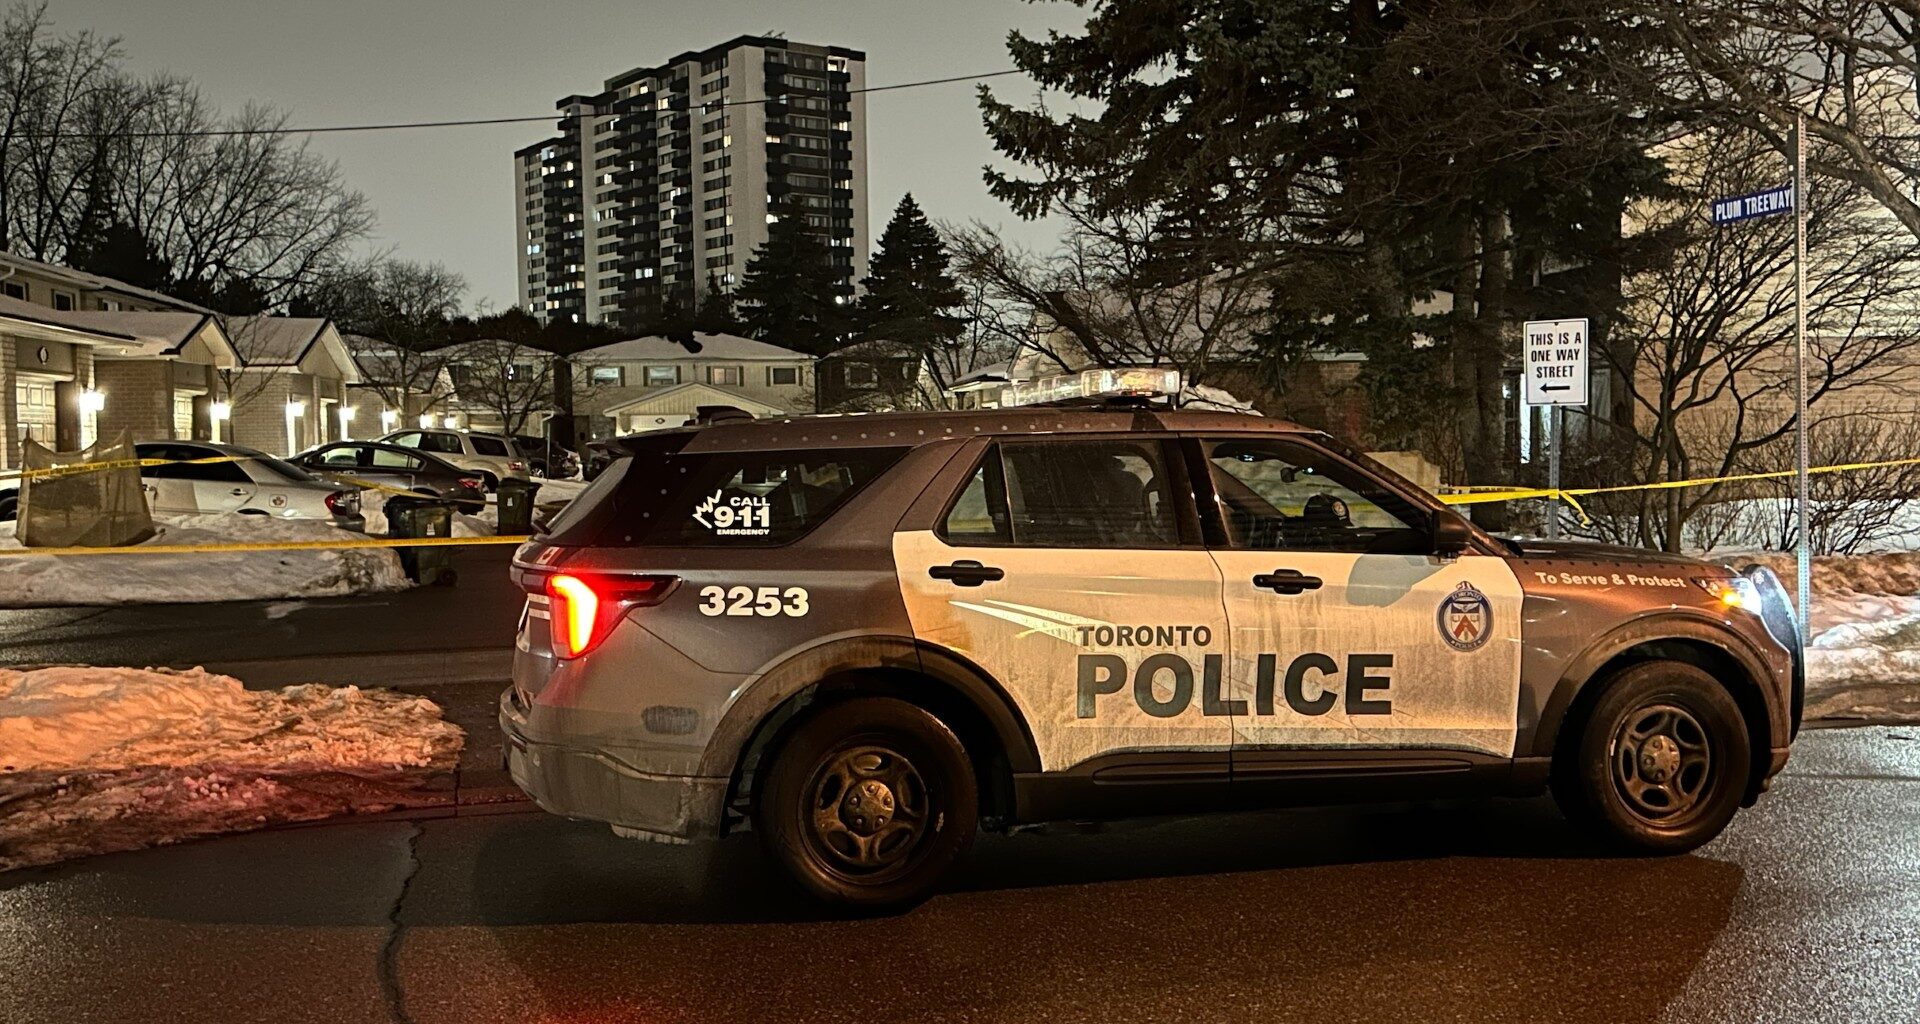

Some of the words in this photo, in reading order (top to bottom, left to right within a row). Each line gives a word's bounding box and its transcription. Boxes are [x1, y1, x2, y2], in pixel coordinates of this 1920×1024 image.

[1715, 200, 1742, 221] PLUM
[1745, 189, 1790, 216] TREEWAY
[1530, 333, 1554, 346] THIS
[1558, 332, 1570, 345] IS
[1574, 332, 1582, 344] A
[1531, 350, 1551, 362] ONE
[1556, 348, 1580, 361] WAY
[1536, 365, 1575, 378] STREET
[730, 497, 771, 507] CALL
[716, 528, 770, 536] EMERGENCY
[1535, 571, 1558, 584] To
[1560, 572, 1608, 586] Serve
[1611, 573, 1626, 586] &
[1627, 573, 1687, 588] Protect
[698, 585, 810, 618] 3253
[1076, 625, 1212, 647] TORONTO
[1076, 653, 1395, 719] POLICE
